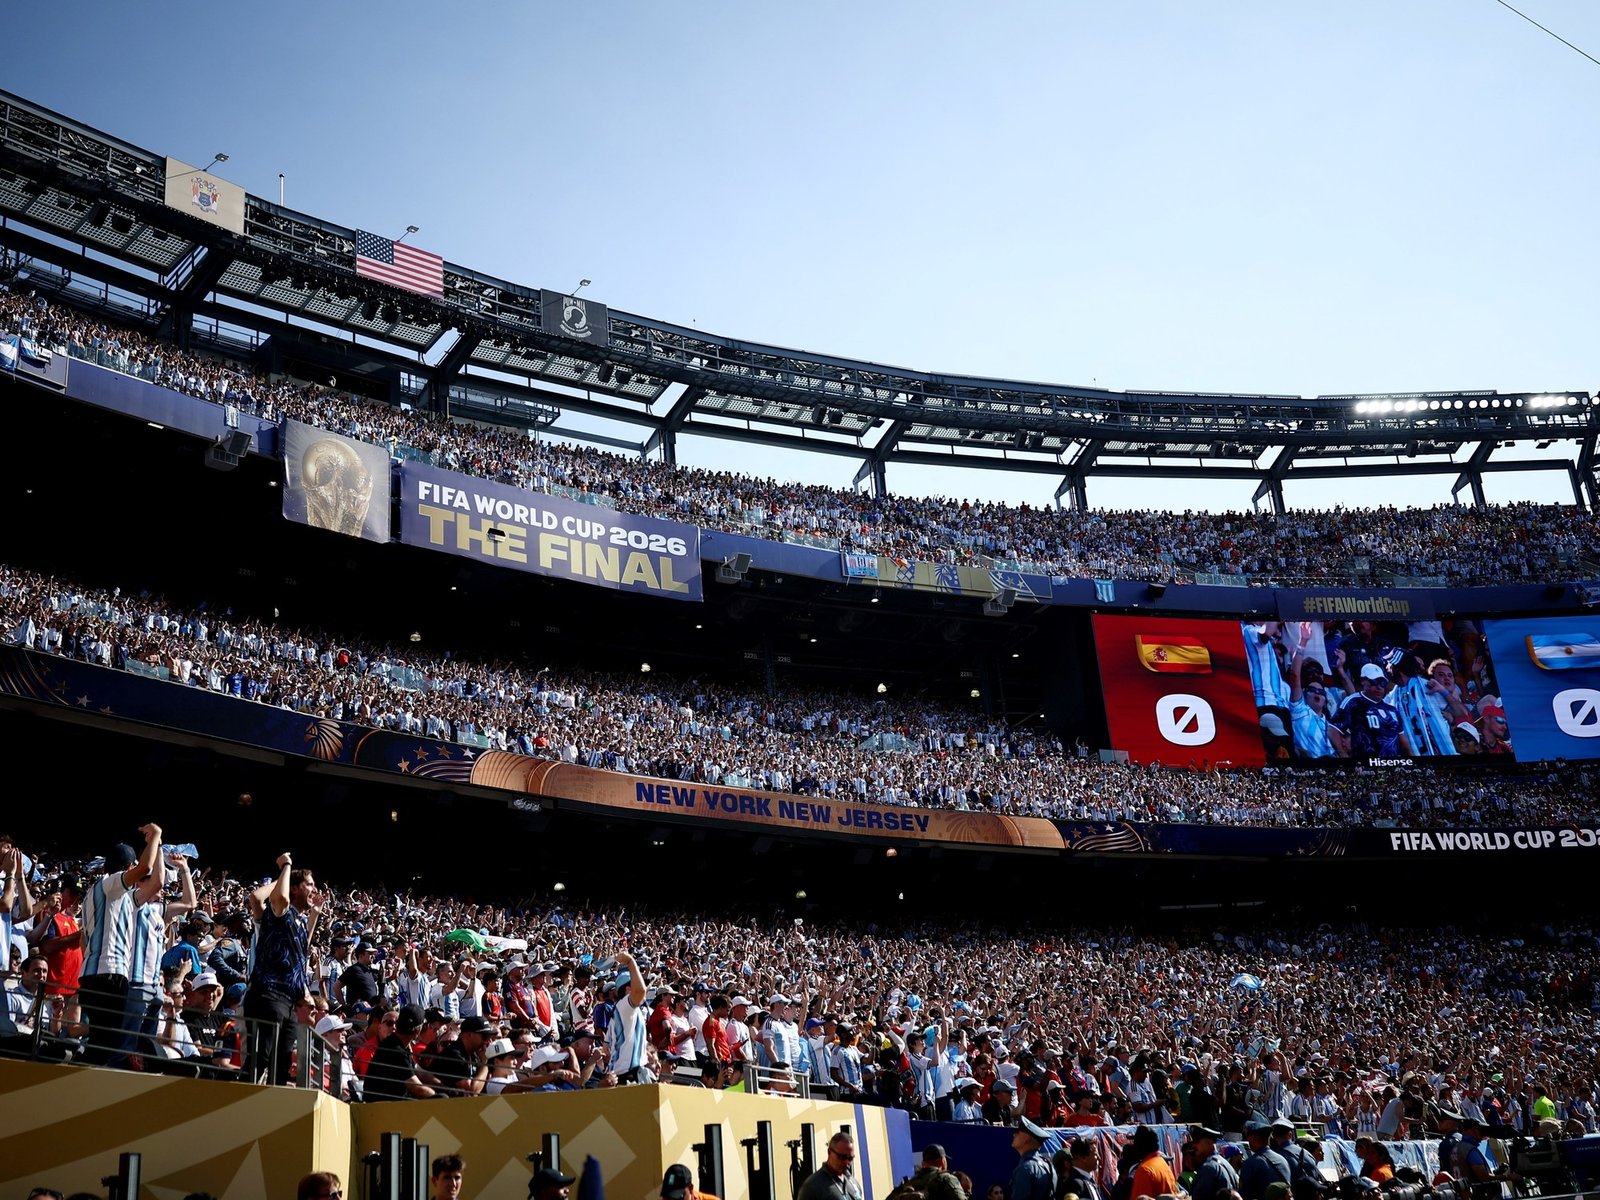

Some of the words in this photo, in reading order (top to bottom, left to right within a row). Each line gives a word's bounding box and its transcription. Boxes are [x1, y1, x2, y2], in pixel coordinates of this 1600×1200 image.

[418, 480, 470, 511] FIFA
[474, 493, 558, 530] WORLD
[562, 516, 606, 540] CUP
[609, 526, 687, 556] 2026
[418, 503, 528, 564] THE
[539, 532, 689, 594] FINAL
[1303, 596, 1410, 617] #FIFAWorldCup
[1155, 693, 1216, 746] 0
[1366, 714, 1380, 729] 10
[1368, 757, 1413, 767] Hisense
[636, 782, 696, 808] NEW
[703, 790, 772, 817] YORK
[778, 800, 831, 824] NEW
[837, 808, 930, 832] JERSEY
[1390, 832, 1436, 851] FIFA
[1436, 832, 1510, 851] WORLD
[1513, 830, 1556, 849] CUP
[1558, 828, 1600, 848] 20
